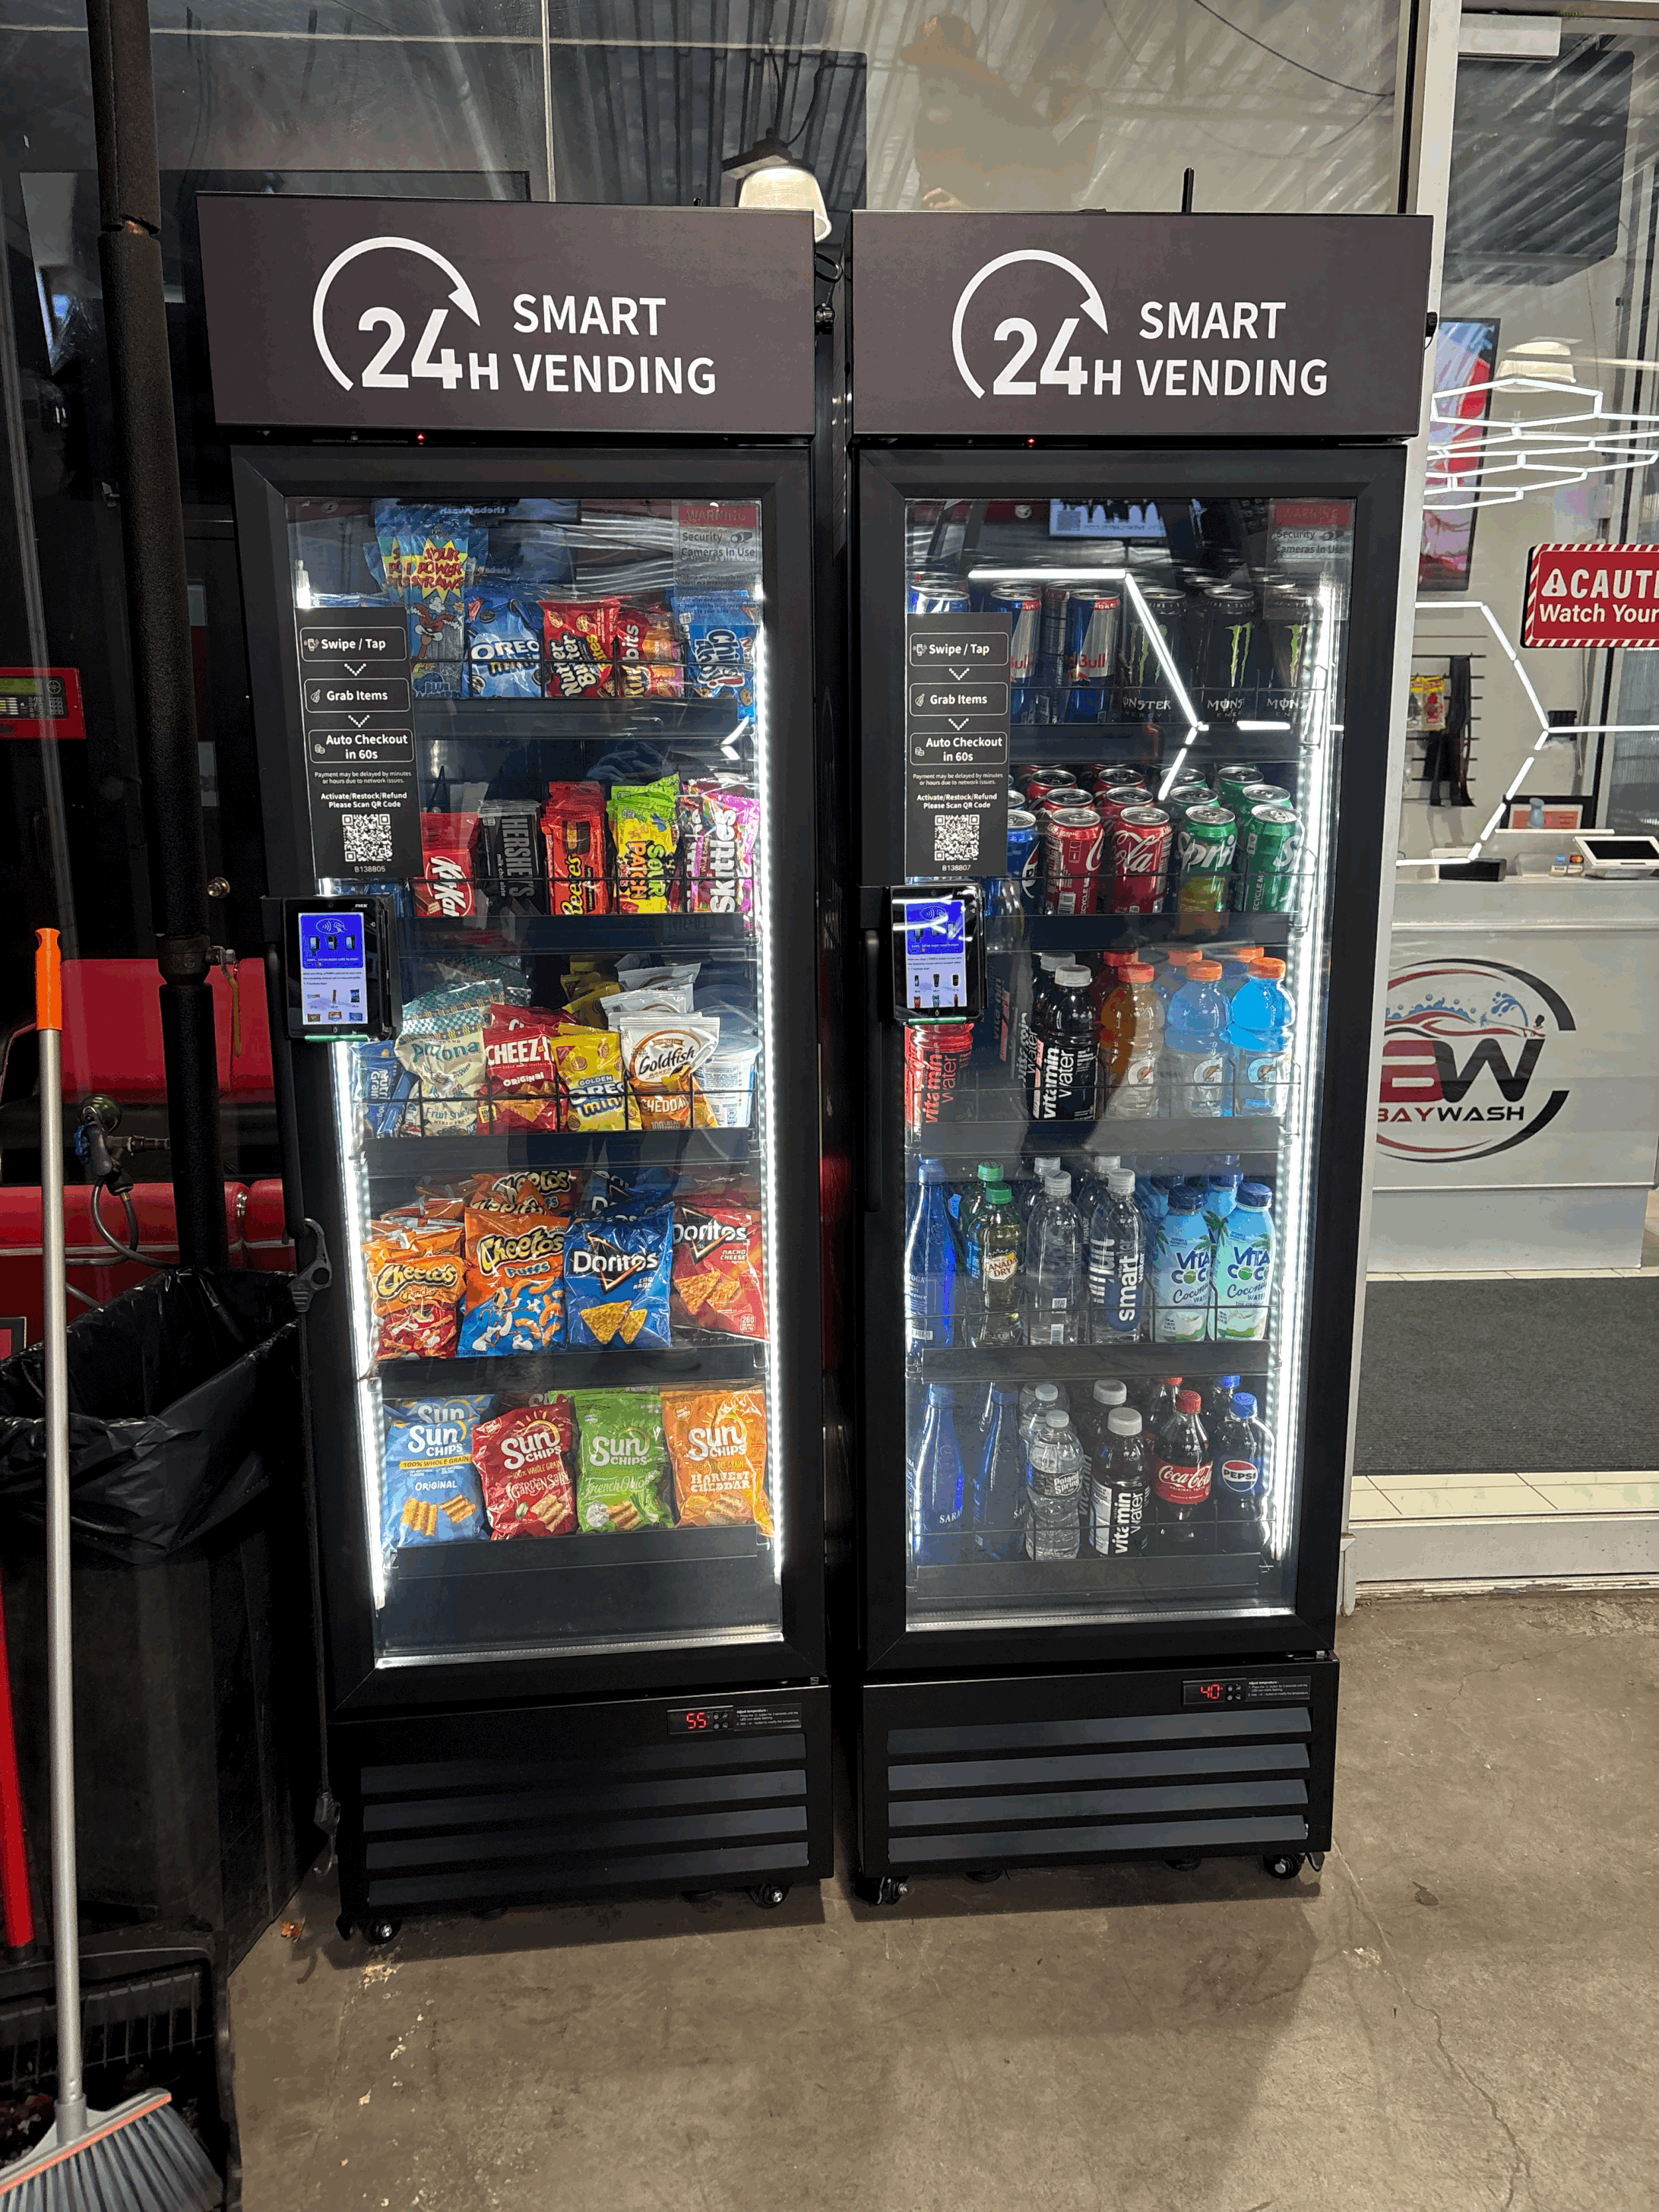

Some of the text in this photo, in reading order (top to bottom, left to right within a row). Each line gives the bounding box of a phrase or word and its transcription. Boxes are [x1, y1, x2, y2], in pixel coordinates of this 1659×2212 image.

[513, 293, 666, 336] SMART
[1139, 301, 1286, 340] SMART
[513, 354, 716, 395] VENDING
[1137, 358, 1328, 396] VENDING
[682, 532, 723, 543] Security
[1277, 530, 1315, 541] Security
[682, 548, 755, 557] Cameras In Use
[1275, 544, 1344, 553] Cameras In Use
[417, 561, 462, 577] POWER
[1539, 603, 1659, 623] Watch Your
[321, 638, 356, 652] Swipe
[365, 638, 386, 651] Tap
[471, 640, 540, 659] OREO
[622, 625, 640, 660] bits
[929, 644, 962, 656] Swipe
[970, 644, 990, 656] Tap
[551, 641, 582, 696] Nutter
[563, 634, 597, 688] Butter
[1079, 653, 1106, 668] Bull
[326, 689, 388, 701] Grab Items
[930, 694, 987, 705] Grab Items
[326, 734, 408, 745] Auto Checkout
[926, 737, 1003, 747] Auto Checkout
[345, 749, 378, 759] in 60s
[943, 751, 974, 761] in 60s
[502, 818, 535, 897] HERSHEY'S
[709, 810, 737, 913] Skittles
[629, 841, 648, 900] PATCH
[647, 844, 666, 897] SOUR
[498, 868, 506, 897] choolate
[561, 855, 583, 915] Reee's
[638, 1045, 696, 1075] Goldfish
[579, 1075, 613, 1086] GOLDEN
[942, 1054, 956, 1103] water
[1043, 1047, 1060, 1119] vitamin
[1058, 1050, 1074, 1098] water
[370, 1070, 380, 1099] Grain
[922, 1053, 942, 1123] vitamin
[426, 1107, 447, 1120] Fruit
[1378, 1106, 1525, 1122] BAYWASH
[673, 1220, 747, 1244] Doritos
[480, 1228, 565, 1273] Cheetos
[1176, 1250, 1210, 1270] VITA
[1234, 1246, 1271, 1266] VITA
[573, 1250, 660, 1273] Doritos
[377, 1264, 458, 1297] Cheetos
[993, 1267, 1011, 1278] DRY
[1118, 1256, 1139, 1321] smart
[417, 1404, 465, 1424] Sun
[407, 1424, 459, 1453] Sun
[687, 1425, 748, 1462] Sun
[425, 1443, 463, 1457] CHIPS
[449, 1455, 469, 1464] GRAIN
[500, 1431, 561, 1470] Sun
[525, 1445, 562, 1463] CHIPS
[589, 1436, 650, 1467] Sun
[610, 1455, 648, 1465] CHIPS
[709, 1443, 747, 1457] CHIPS
[1053, 1472, 1080, 1487] Poland
[1223, 1468, 1256, 1480] PEPSI
[691, 1479, 751, 1493] CHEDDAR
[1054, 1479, 1080, 1495] Spring
[1114, 1492, 1131, 1554] vitamin
[1130, 1492, 1143, 1534] water
[1200, 1683, 1220, 1700] 40
[685, 1712, 707, 1730] 55
